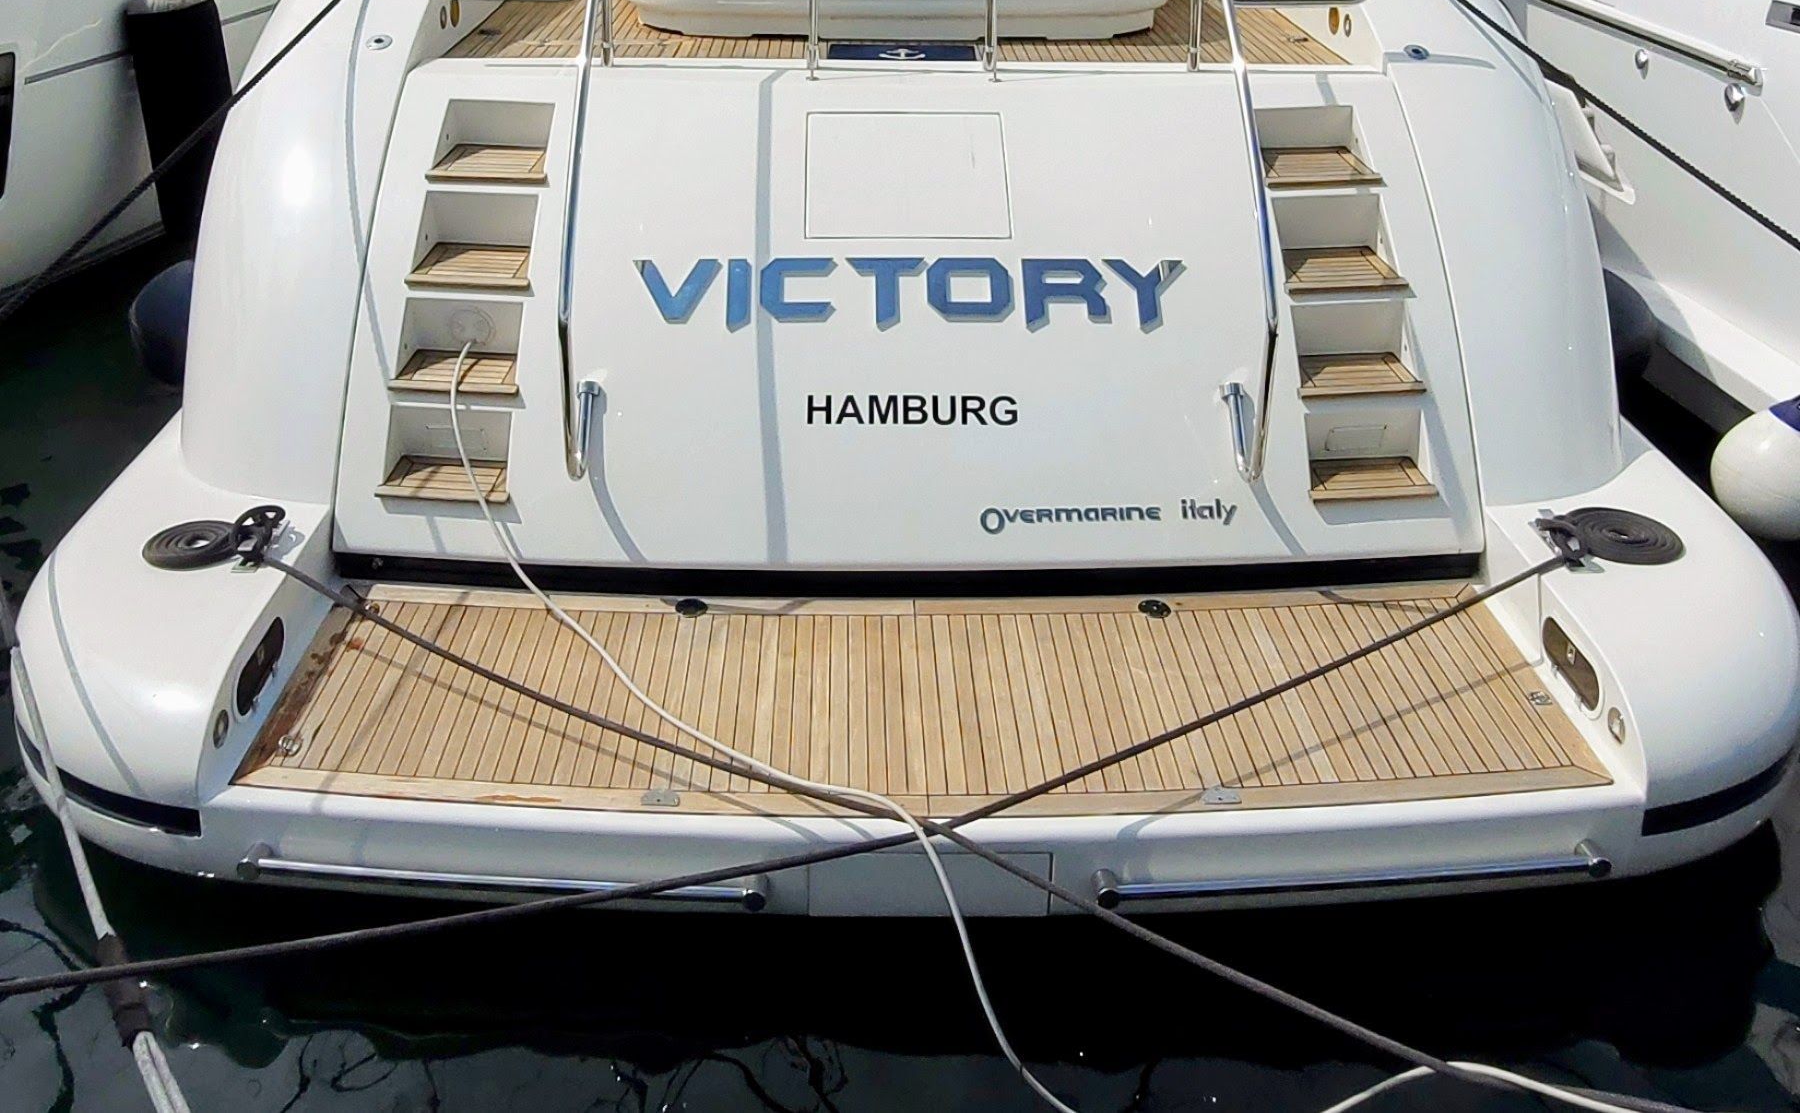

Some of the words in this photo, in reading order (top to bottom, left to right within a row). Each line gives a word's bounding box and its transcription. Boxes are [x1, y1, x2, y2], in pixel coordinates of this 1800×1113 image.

[632, 257, 1187, 334] VICTORY
[806, 394, 1019, 426] HAMBURG
[1180, 498, 1238, 526] italy
